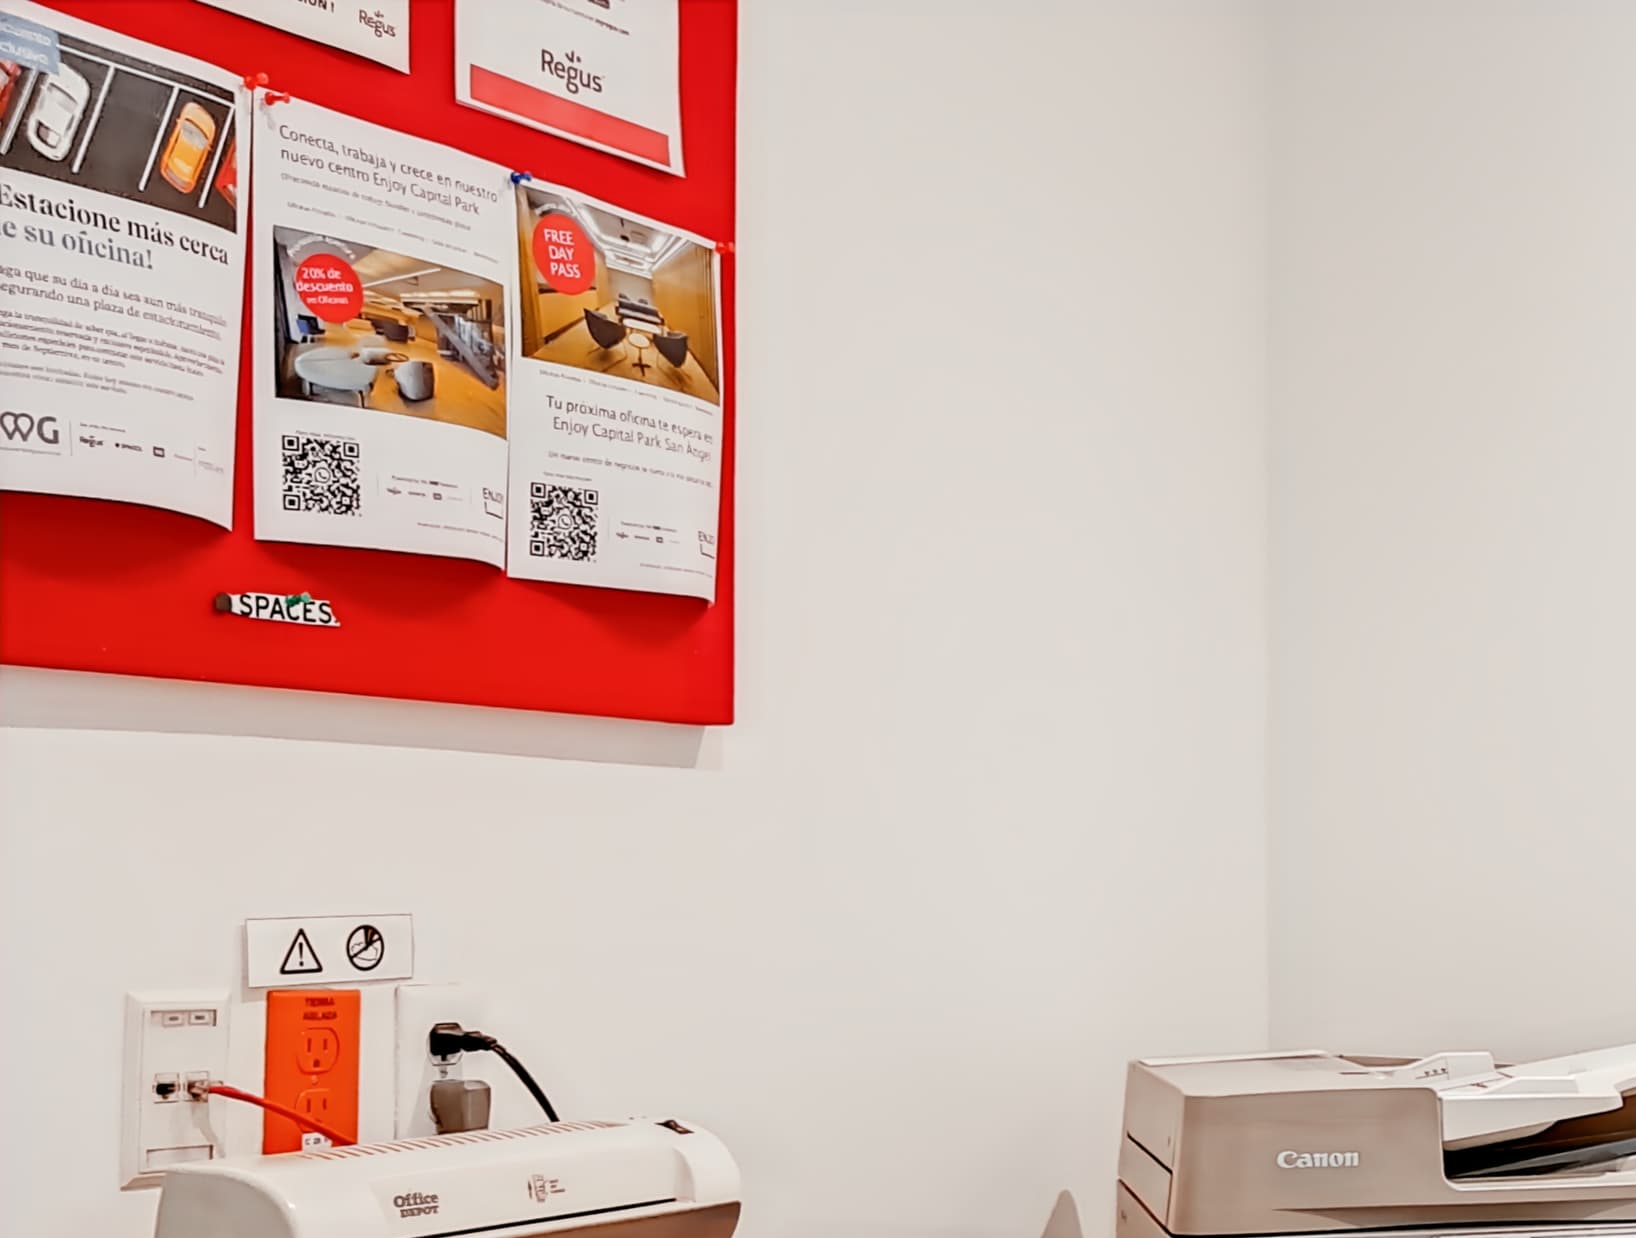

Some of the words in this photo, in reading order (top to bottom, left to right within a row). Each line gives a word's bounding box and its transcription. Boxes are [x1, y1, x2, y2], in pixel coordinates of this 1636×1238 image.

[359, 9, 396, 38] Regus
[541, 49, 602, 94] Regus
[280, 124, 339, 154] Conecta,
[342, 144, 386, 168] trabaja
[390, 161, 397, 173] y
[401, 163, 433, 182] crece
[437, 174, 452, 187] en
[455, 179, 498, 203] nuestro
[281, 148, 324, 170] nuevo
[328, 160, 369, 182] centro
[373, 172, 407, 196] Enjoy
[455, 196, 480, 216] Park
[0, 183, 120, 232] Estacione
[127, 221, 174, 247] más
[179, 234, 229, 265] cerca
[0, 218, 17, 239] e
[24, 223, 55, 246] su
[543, 228, 575, 246] FREE
[548, 245, 574, 261] DAY
[550, 261, 581, 279] PASS
[546, 394, 563, 411] Tu
[553, 415, 588, 437] Enjoy
[240, 594, 332, 624] SPACES
[1276, 1150, 1360, 1169] Canon
[393, 1192, 439, 1209] Office
[400, 1204, 439, 1218] DEPOT
